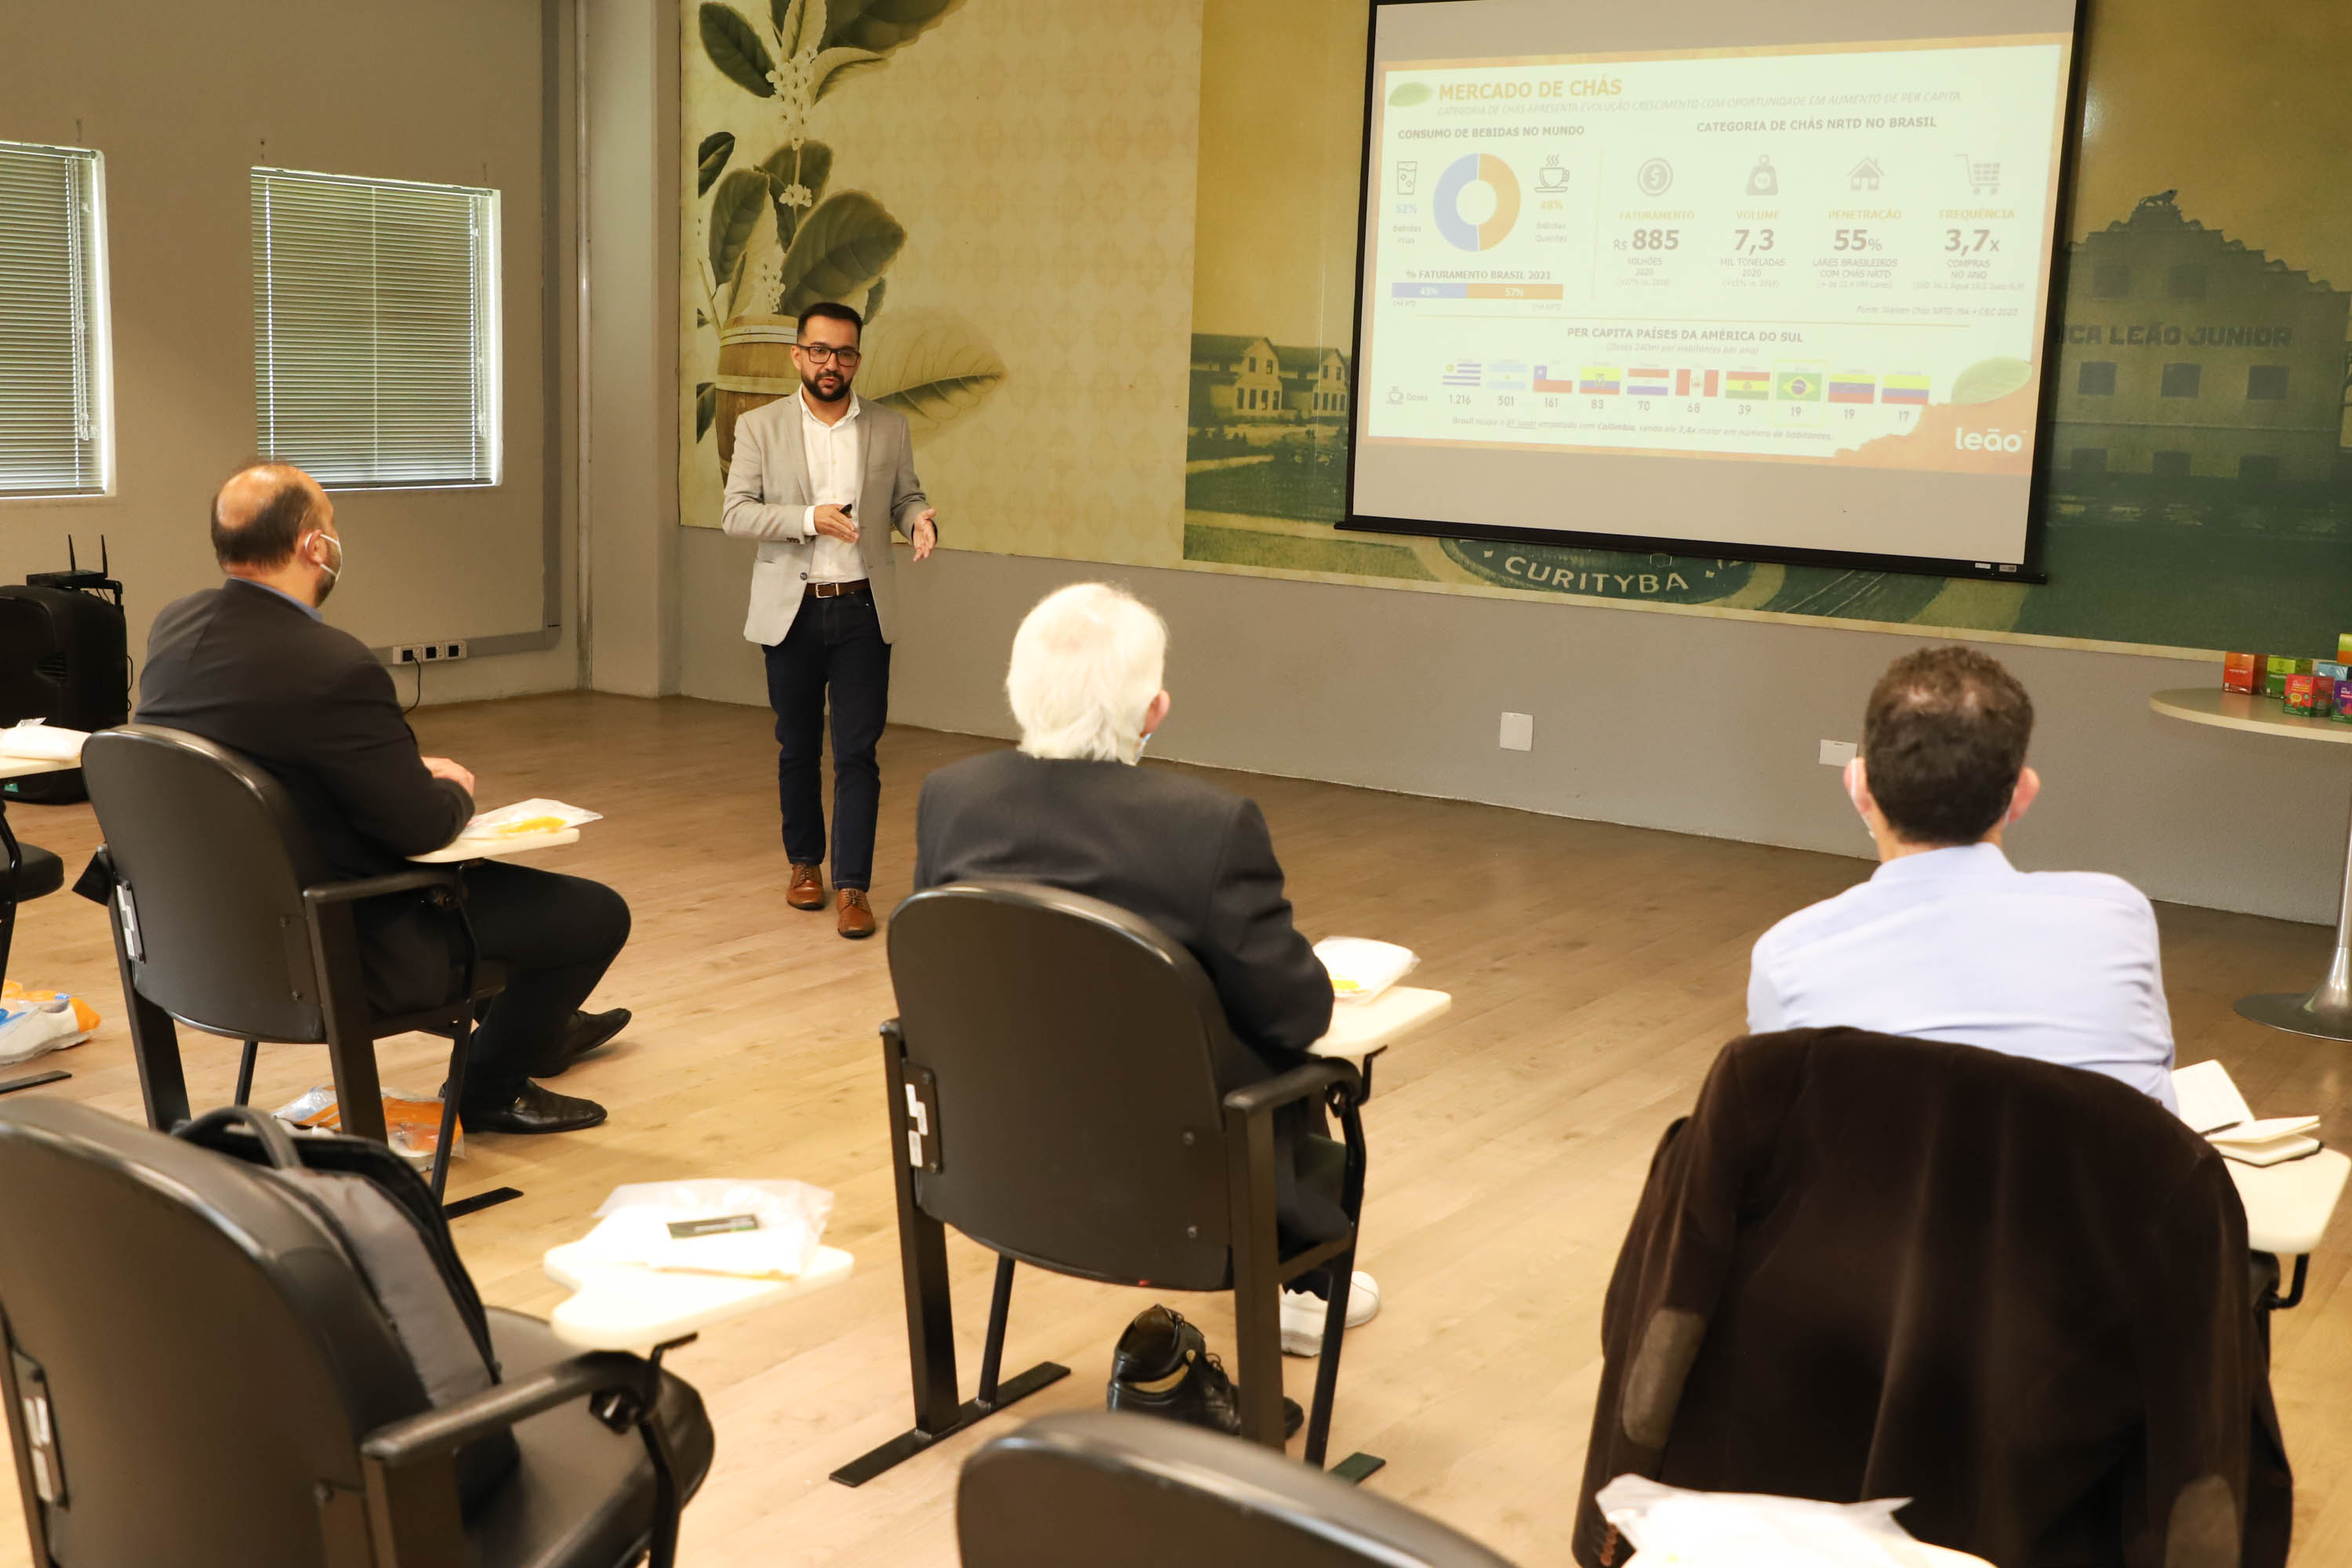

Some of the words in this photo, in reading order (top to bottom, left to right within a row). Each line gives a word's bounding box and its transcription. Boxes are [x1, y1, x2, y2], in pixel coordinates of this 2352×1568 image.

[1439, 82, 1532, 100] MERCADO
[1539, 80, 1563, 98] DE
[1570, 74, 1622, 96] CHÁS
[1438, 105, 1486, 116] CATEGORIA
[1488, 104, 1500, 114] DE
[1501, 103, 1526, 114] CHÁS
[1528, 102, 1578, 114] APRESENTA
[1632, 98, 1699, 111] CRESCIMENTO
[1700, 97, 1726, 109] COM
[1726, 95, 1807, 108] OPORTUNIDADE
[1809, 95, 1827, 106] EM
[1828, 93, 1882, 105] AUMENTO
[1883, 93, 1900, 103] DE
[1900, 92, 1921, 103] PER
[1697, 121, 1766, 132] CATEGORIA
[1770, 120, 1786, 131] DE
[1791, 117, 1823, 130] CHÁS
[1827, 118, 1862, 129] NRTD
[1866, 118, 1885, 129] NO
[1889, 116, 1938, 128] BRASIL
[1399, 128, 1451, 140] CONSUMO
[1454, 128, 1468, 138] DE
[1472, 127, 1519, 138] BEBIDAS
[1523, 126, 1539, 137] NO
[1542, 125, 1584, 136] MUNDO
[1396, 203, 1417, 214] 52%
[1539, 200, 1564, 212] 48%
[1618, 209, 1696, 221] FATURAMENTO
[1736, 209, 1780, 220] VOLUME
[1828, 207, 1902, 222] PENETRAÇÃO
[1938, 207, 2016, 222] FREQUÊNCIA
[1632, 229, 1680, 251] 885
[1734, 228, 1775, 256] 7,3
[1833, 228, 1882, 252] 55%
[1944, 227, 2001, 257] 3,7x
[1720, 257, 1734, 267] MIL
[1737, 257, 1787, 267] TONELADAS
[1946, 258, 1991, 269] COMPRAS
[1418, 270, 1488, 280] FATURAMENTO
[1490, 270, 1526, 280] BRASIL
[1528, 270, 1552, 281] 2021
[1741, 268, 1762, 278] 2020
[1820, 270, 1840, 278] COM
[1951, 270, 1965, 279] NO
[1966, 270, 1987, 280] ANO
[1568, 327, 1588, 338] PER
[1592, 328, 1633, 339] CAPITA
[1636, 327, 1678, 339] PAÍSES
[1681, 329, 1697, 339] DA
[1700, 328, 1755, 342] AMÉRICA
[1759, 332, 1777, 342] DO
[1780, 332, 1804, 343] SUL
[2109, 320, 2182, 346] LEÃO
[2187, 325, 2293, 347] JUNIOR
[1406, 393, 1428, 402] Doses
[1497, 395, 1515, 408] 501
[1544, 397, 1559, 408] 161
[1591, 398, 1605, 410] 83
[1637, 400, 1651, 412] 70
[1686, 401, 1700, 414] 68
[1737, 404, 1752, 416] 39
[1790, 405, 1802, 417] 19
[1843, 408, 1856, 419] 19
[1898, 409, 1911, 421] 17
[1955, 426, 2023, 452] leão
[1504, 556, 1690, 594] CURITYBA
